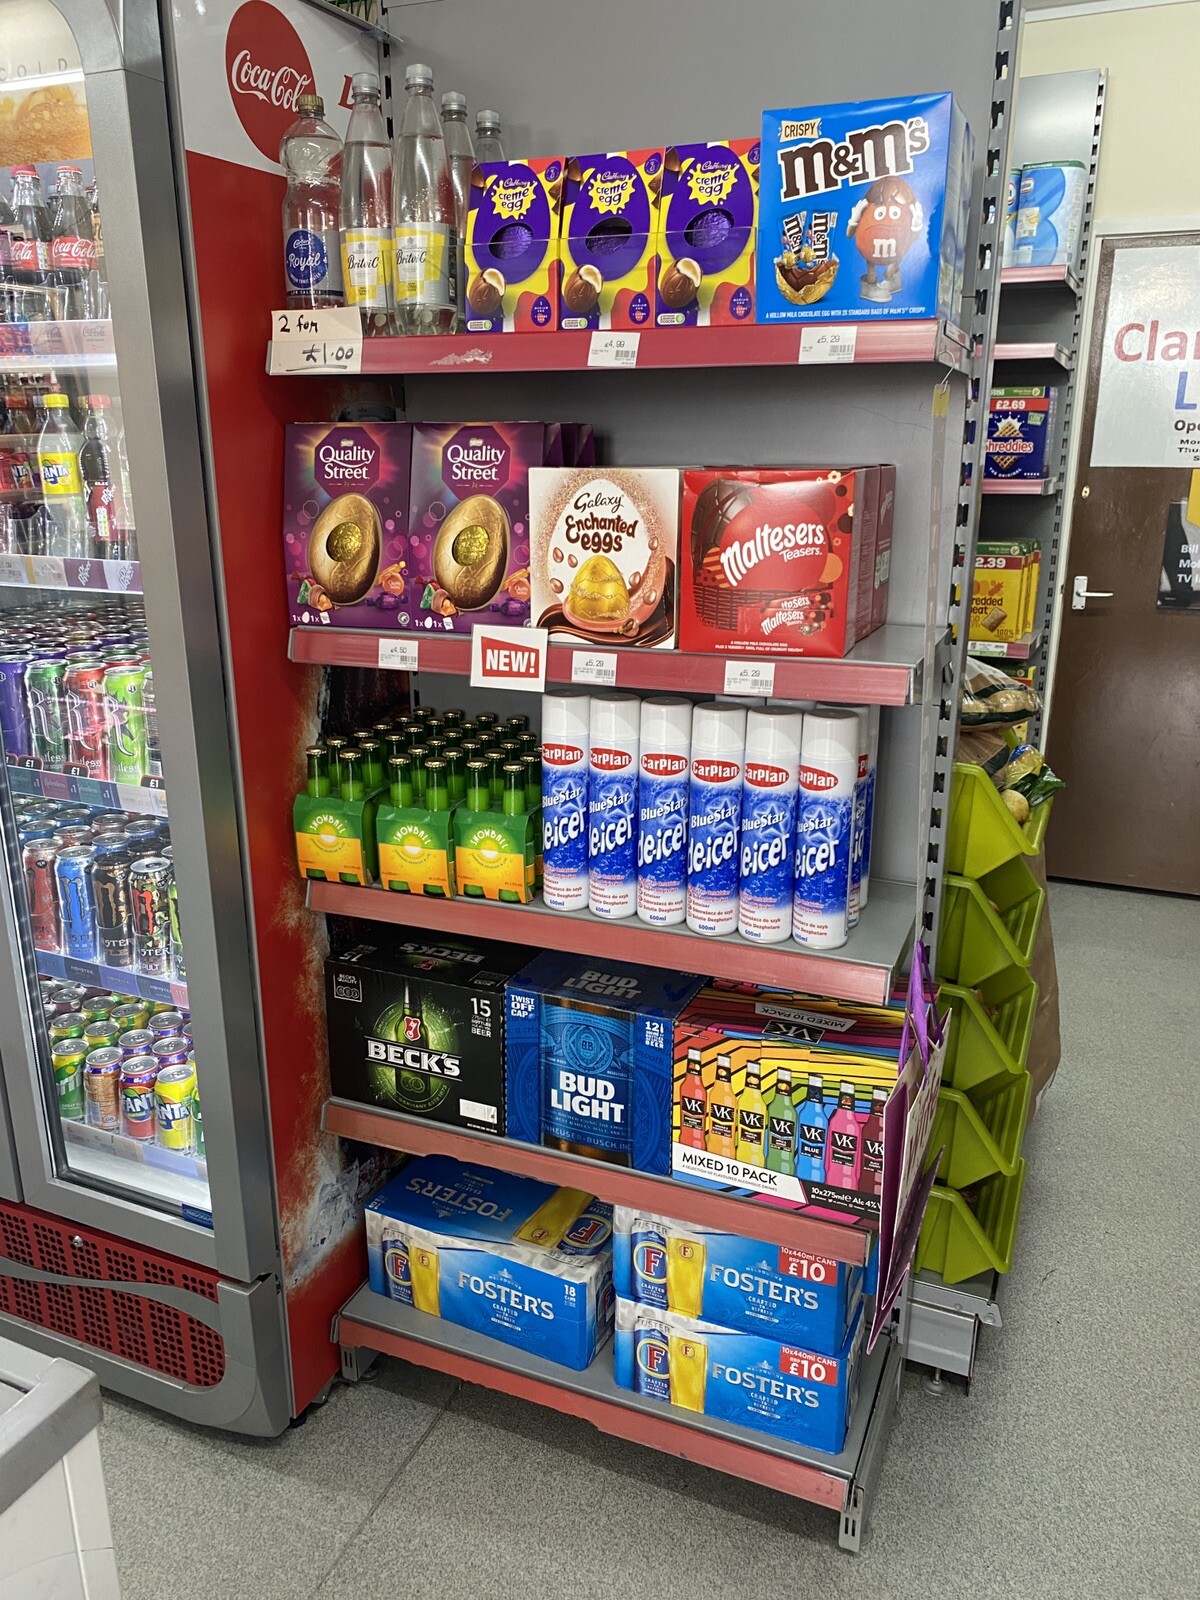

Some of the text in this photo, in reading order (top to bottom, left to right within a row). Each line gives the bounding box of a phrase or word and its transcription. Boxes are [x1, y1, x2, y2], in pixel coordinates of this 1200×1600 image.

[231, 50, 311, 112] Coca-Col
[784, 121, 818, 138] CRISPY
[695, 170, 730, 186] creme
[498, 185, 530, 201] creme
[595, 181, 629, 195] creme
[698, 182, 723, 197] egg
[501, 199, 523, 212] egg
[598, 192, 623, 206] egg
[288, 253, 321, 271] Royal
[278, 314, 318, 333] 2 for
[817, 335, 840, 343] £5.29
[302, 343, 353, 364] £1.00
[996, 400, 1026, 410] £2.69
[319, 445, 375, 468] Quality
[447, 445, 505, 468] Quality
[324, 464, 369, 480] Street
[452, 464, 499, 481] Street
[574, 492, 624, 513] Galaxy
[565, 512, 639, 544] Enchanted
[580, 532, 623, 553] eggs
[720, 523, 825, 586] Maltesers
[779, 547, 822, 563] Teasers
[975, 558, 1006, 568] 2.39
[971, 605, 988, 614] eat
[761, 610, 804, 635] Maltesers
[485, 649, 536, 674] NEW!
[25, 760, 34, 768] £1
[71, 767, 80, 775] £1
[641, 756, 686, 771] CarPlan
[692, 761, 739, 777] CarPlan
[744, 764, 788, 782] CarPlan
[150, 780, 159, 788] £1
[543, 787, 582, 808] BlueStar
[590, 792, 630, 814] BlueStar
[641, 797, 686, 821] BlueStar
[691, 804, 737, 828] BlueStar
[310, 814, 346, 834] SNOWBALL
[742, 810, 786, 832] BlueStar
[393, 825, 431, 845] SNOWBALL
[470, 829, 508, 849] SNOWBALL
[595, 906, 611, 914] 600ml
[745, 929, 761, 938] 600ml
[580, 970, 639, 988] BUD
[562, 977, 641, 999] LIGHT
[471, 997, 492, 1018] 15
[510, 994, 535, 1005] TWIST
[511, 1002, 535, 1012] OFF
[511, 1009, 528, 1018] CAP
[761, 1007, 791, 1017] PACK
[645, 1021, 660, 1032] 12
[807, 1017, 847, 1028] MIXED
[471, 1028, 492, 1038] BEER
[773, 1023, 812, 1041] VK
[367, 1040, 461, 1077] BECK'S
[559, 1070, 615, 1100] BUD
[551, 1088, 625, 1123] LIGHT
[684, 1098, 703, 1113] VK
[713, 1105, 732, 1120] VK
[742, 1112, 762, 1127] VK
[772, 1119, 793, 1134] VK
[803, 1126, 823, 1142] VK
[833, 1133, 854, 1149] VK
[804, 1145, 820, 1153] BLUE
[866, 1140, 883, 1155] VK
[682, 1152, 778, 1186] MIXED 10 PACK
[713, 1172, 736, 1181] FLAVOURED
[737, 1178, 761, 1187] ALCOHOLIC
[405, 1178, 514, 1222] FOSTER'S
[852, 1197, 864, 1206] Alc
[865, 1201, 877, 1209] 4%
[644, 1247, 663, 1275] F
[781, 1247, 837, 1267] 10x440ml CANS
[393, 1254, 407, 1279] F
[789, 1260, 826, 1282] £10
[564, 1284, 576, 1297] 18
[710, 1264, 819, 1310] FOSTER'S
[458, 1271, 555, 1321] FOSTER'S
[748, 1296, 777, 1308] CRAFTED
[492, 1303, 518, 1317] CRAFTED
[647, 1344, 665, 1371] F
[782, 1347, 837, 1367] 10x440ml CANS
[789, 1360, 826, 1381] £10
[712, 1362, 820, 1409] FOSTER'S
